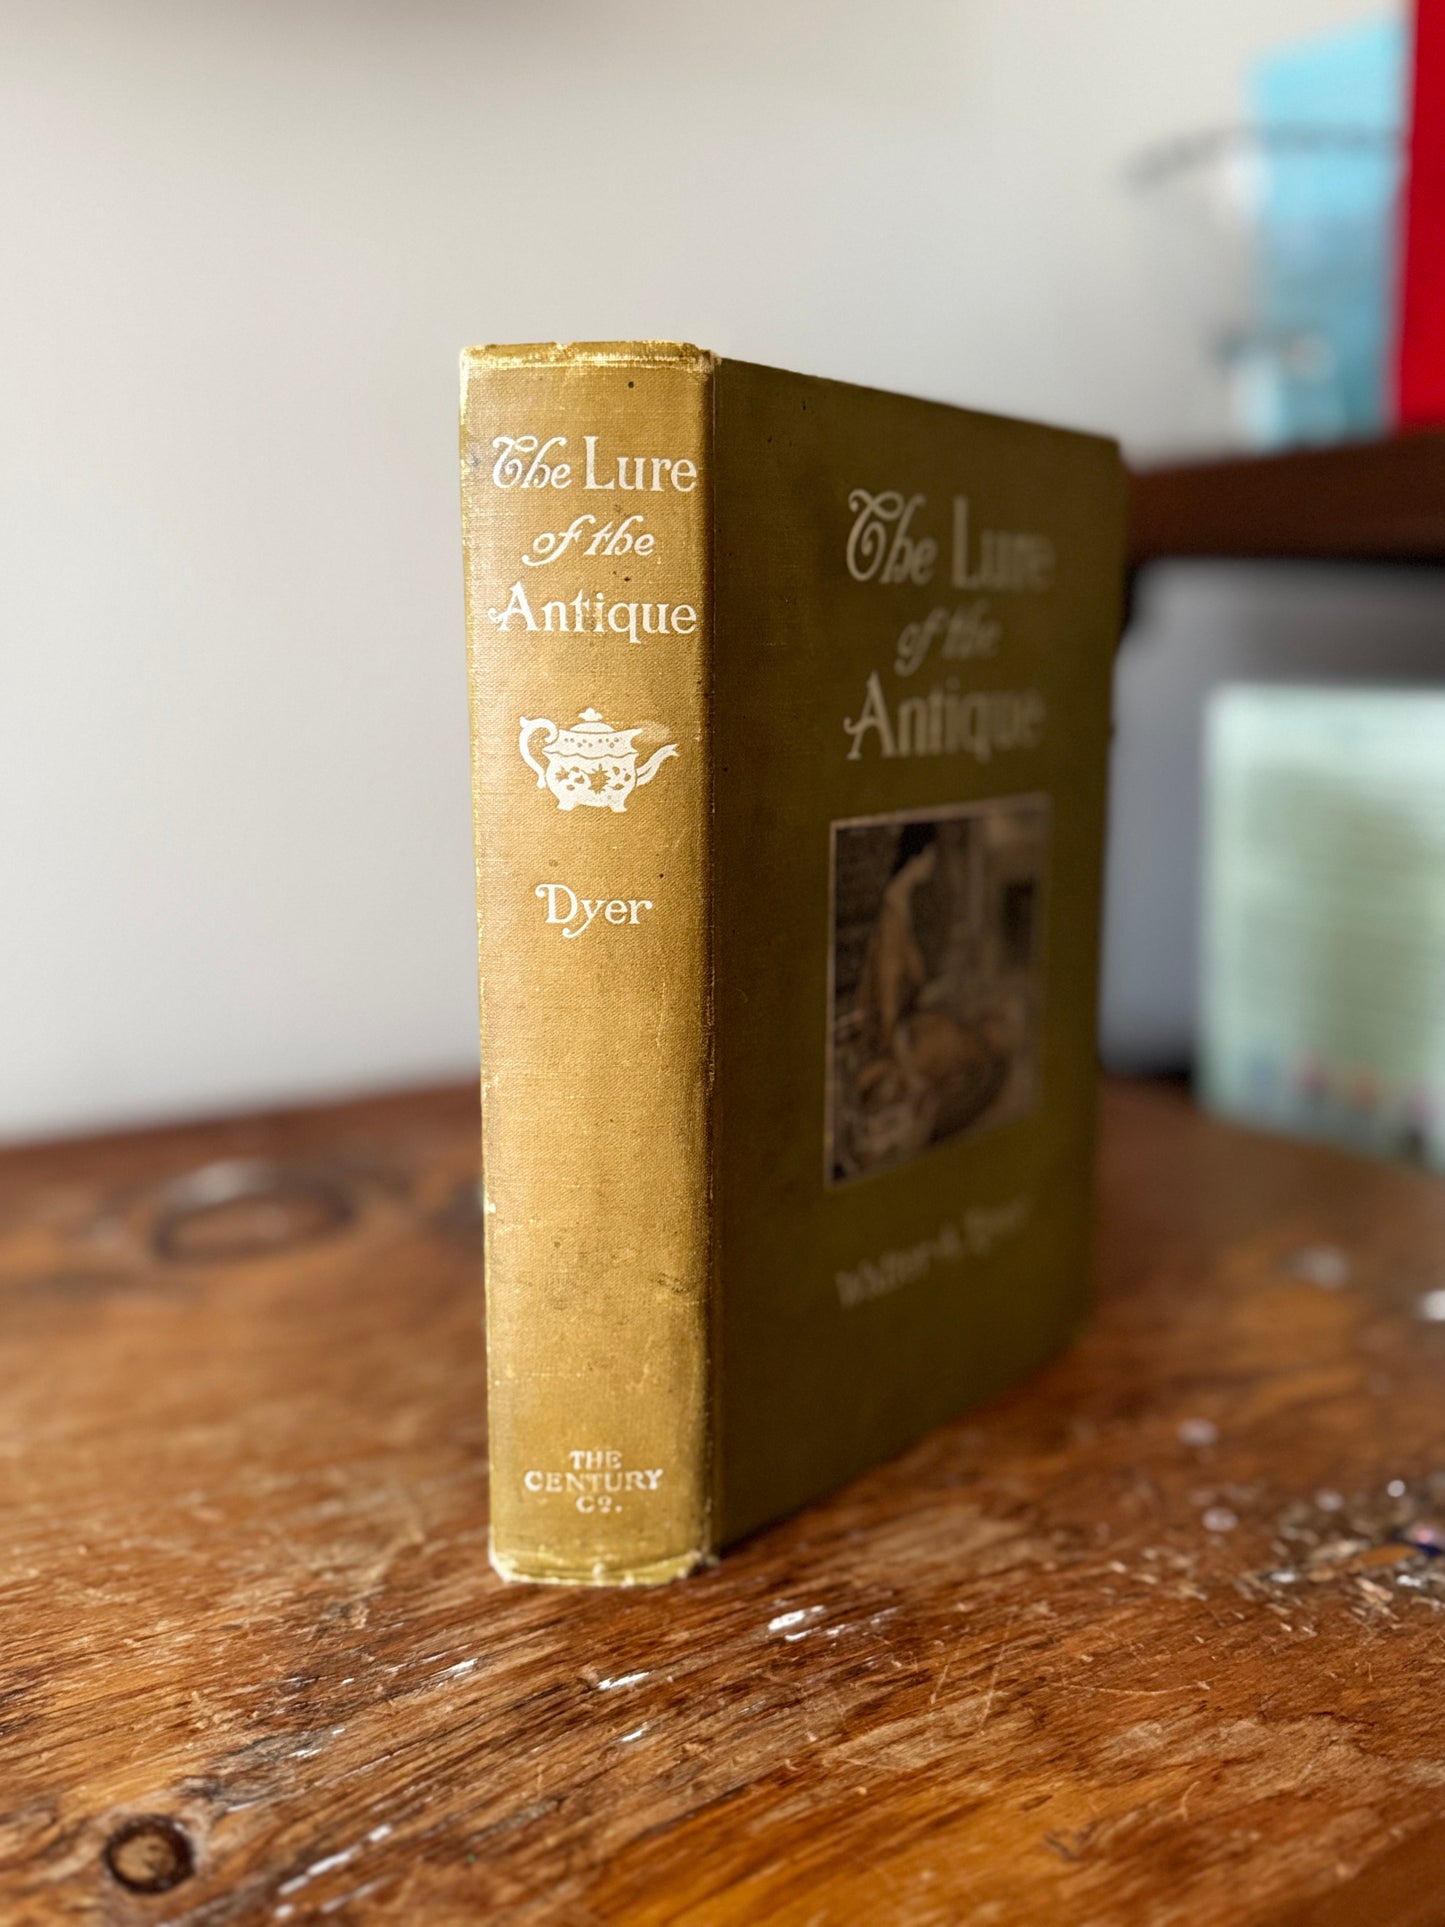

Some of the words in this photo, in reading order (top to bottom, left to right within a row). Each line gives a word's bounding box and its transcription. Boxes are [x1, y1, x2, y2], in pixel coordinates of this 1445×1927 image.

[491, 435, 572, 489] The
[583, 435, 697, 492] Lure
[521, 513, 596, 566] of
[583, 514, 655, 556] the
[846, 488, 939, 585] The
[487, 580, 697, 644] Antique
[534, 883, 653, 938] Dyer
[524, 1468, 664, 1493] CENTURY
[568, 1450, 623, 1471] THE
